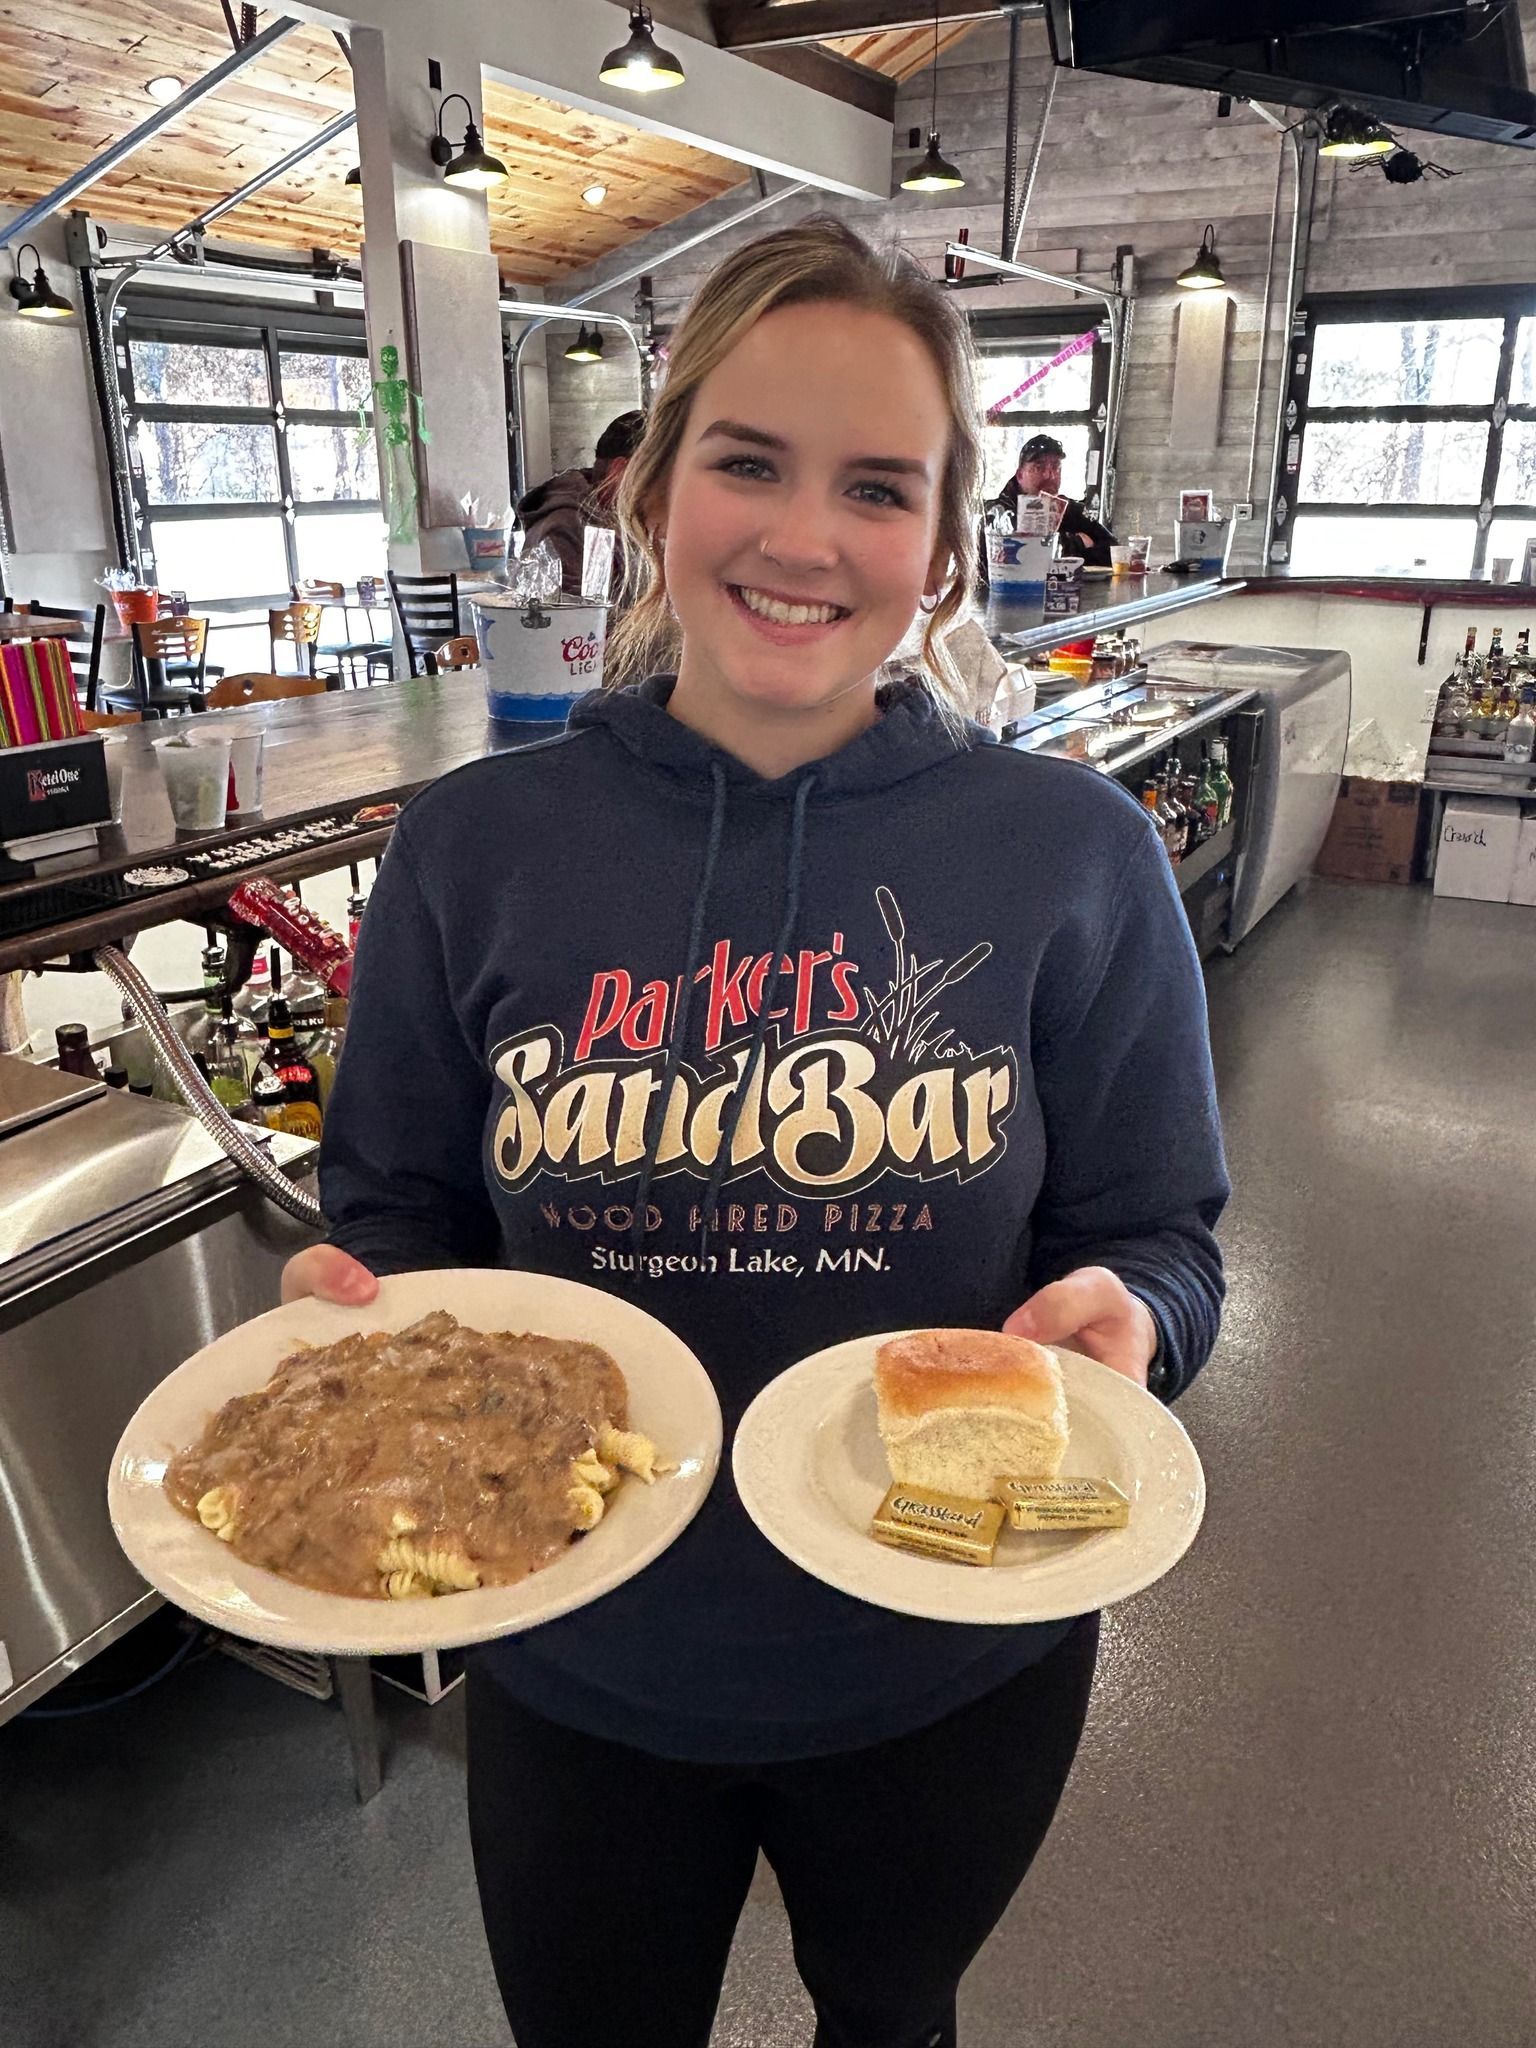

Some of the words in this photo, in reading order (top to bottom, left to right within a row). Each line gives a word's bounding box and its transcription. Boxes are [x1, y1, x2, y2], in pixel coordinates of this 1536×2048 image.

[561, 636, 599, 662] Coo
[60, 768, 79, 783] One
[824, 1203, 933, 1232] PIZZA
[591, 1247, 718, 1278] Sturgeon
[729, 1248, 804, 1278] Lake,
[815, 1248, 891, 1273] MN.
